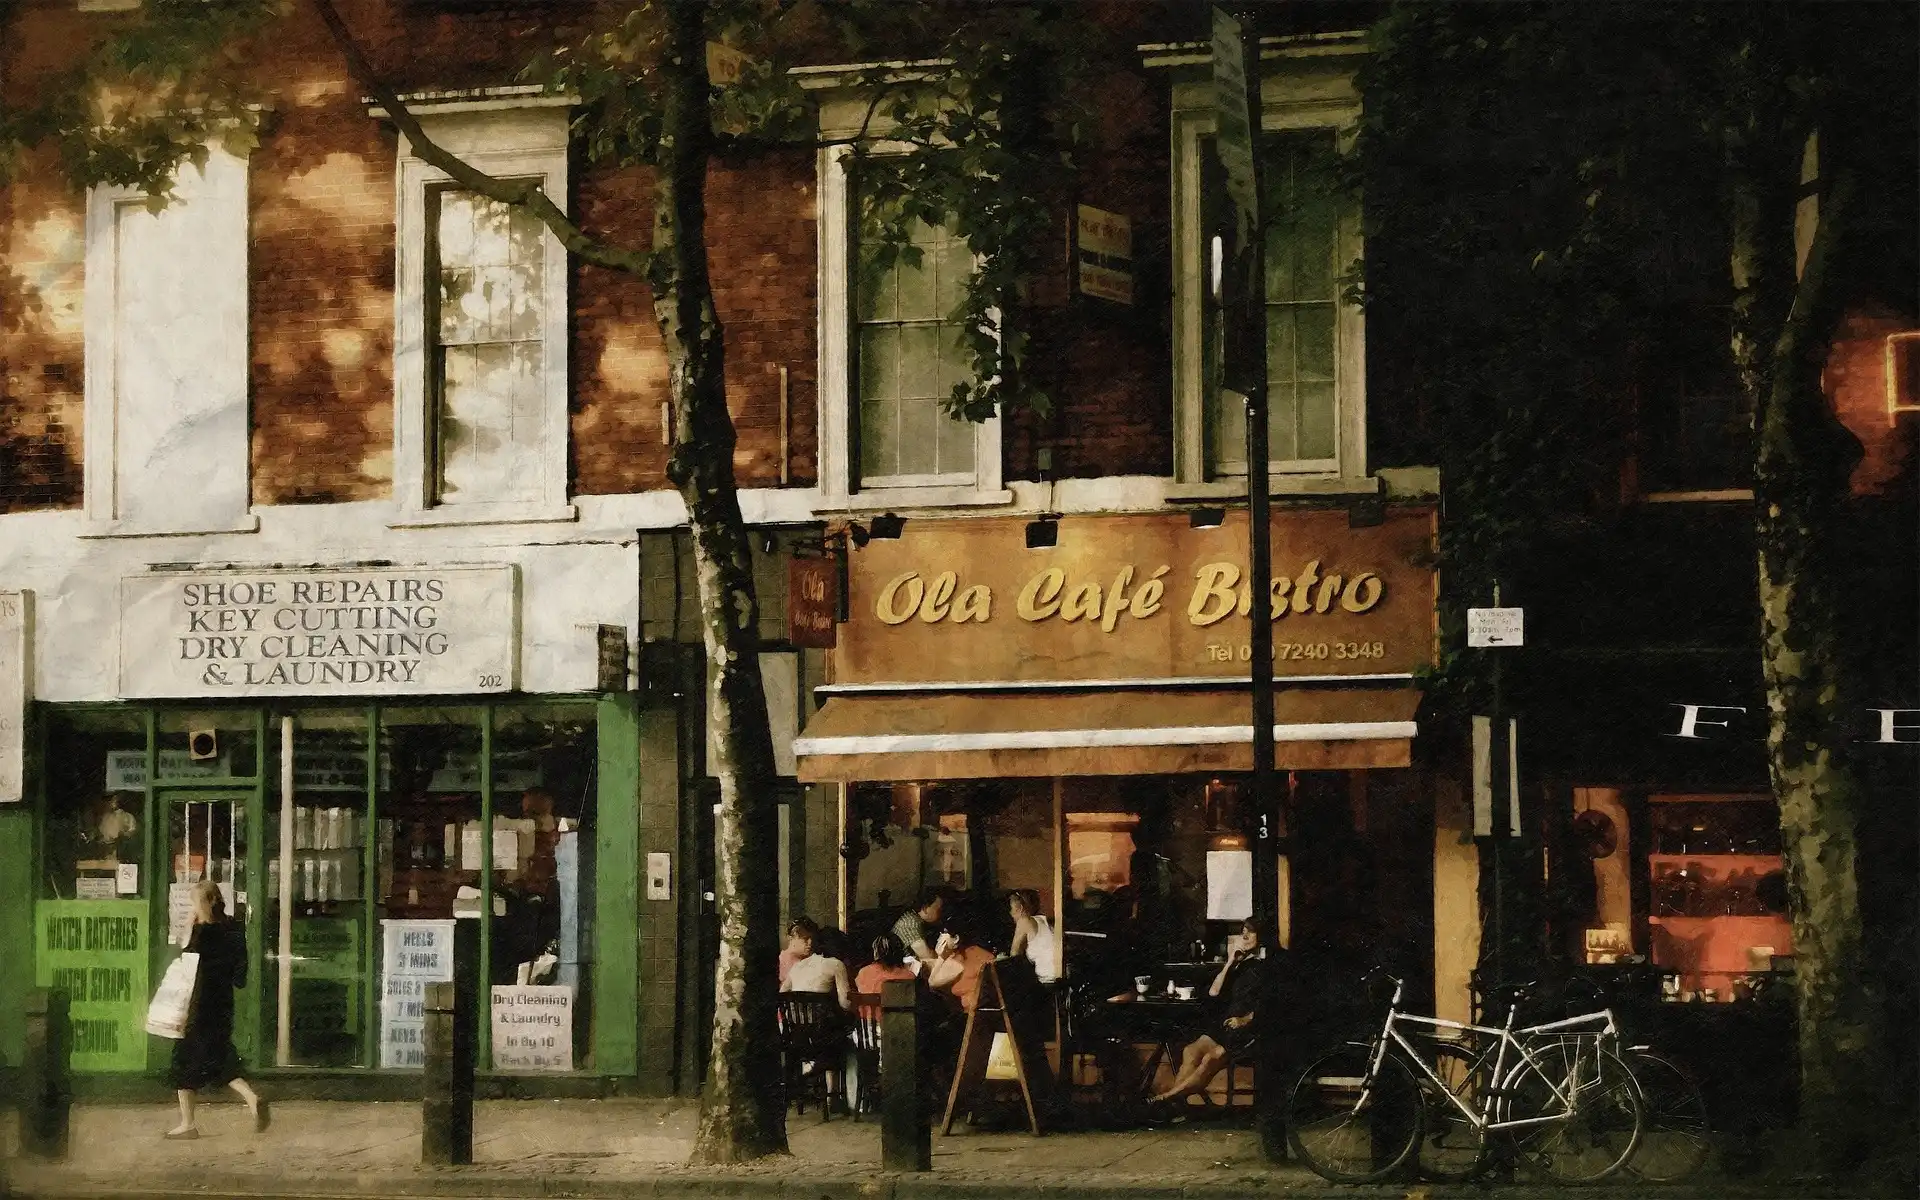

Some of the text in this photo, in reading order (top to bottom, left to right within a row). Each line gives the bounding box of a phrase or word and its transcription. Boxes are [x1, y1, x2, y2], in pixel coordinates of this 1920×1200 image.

[183, 579, 444, 606] SHOE REPAIRS
[876, 571, 992, 625] Ola
[1017, 564, 1171, 633] Café
[188, 606, 437, 632] KEY CUTTING
[180, 632, 449, 659] DRY CLEANING
[1207, 644, 1233, 661] Tel
[1281, 643, 1329, 660] 7240
[1335, 642, 1385, 660] 3348
[203, 660, 420, 685] & LAUNDRY
[479, 674, 503, 688] 202
[47, 917, 139, 951] WATCH BATTERIES
[91, 967, 131, 1002] STRAPS
[493, 993, 568, 1008] Dry Cleaning
[501, 1012, 561, 1027] & Laundry
[541, 1036, 555, 1047] 10
